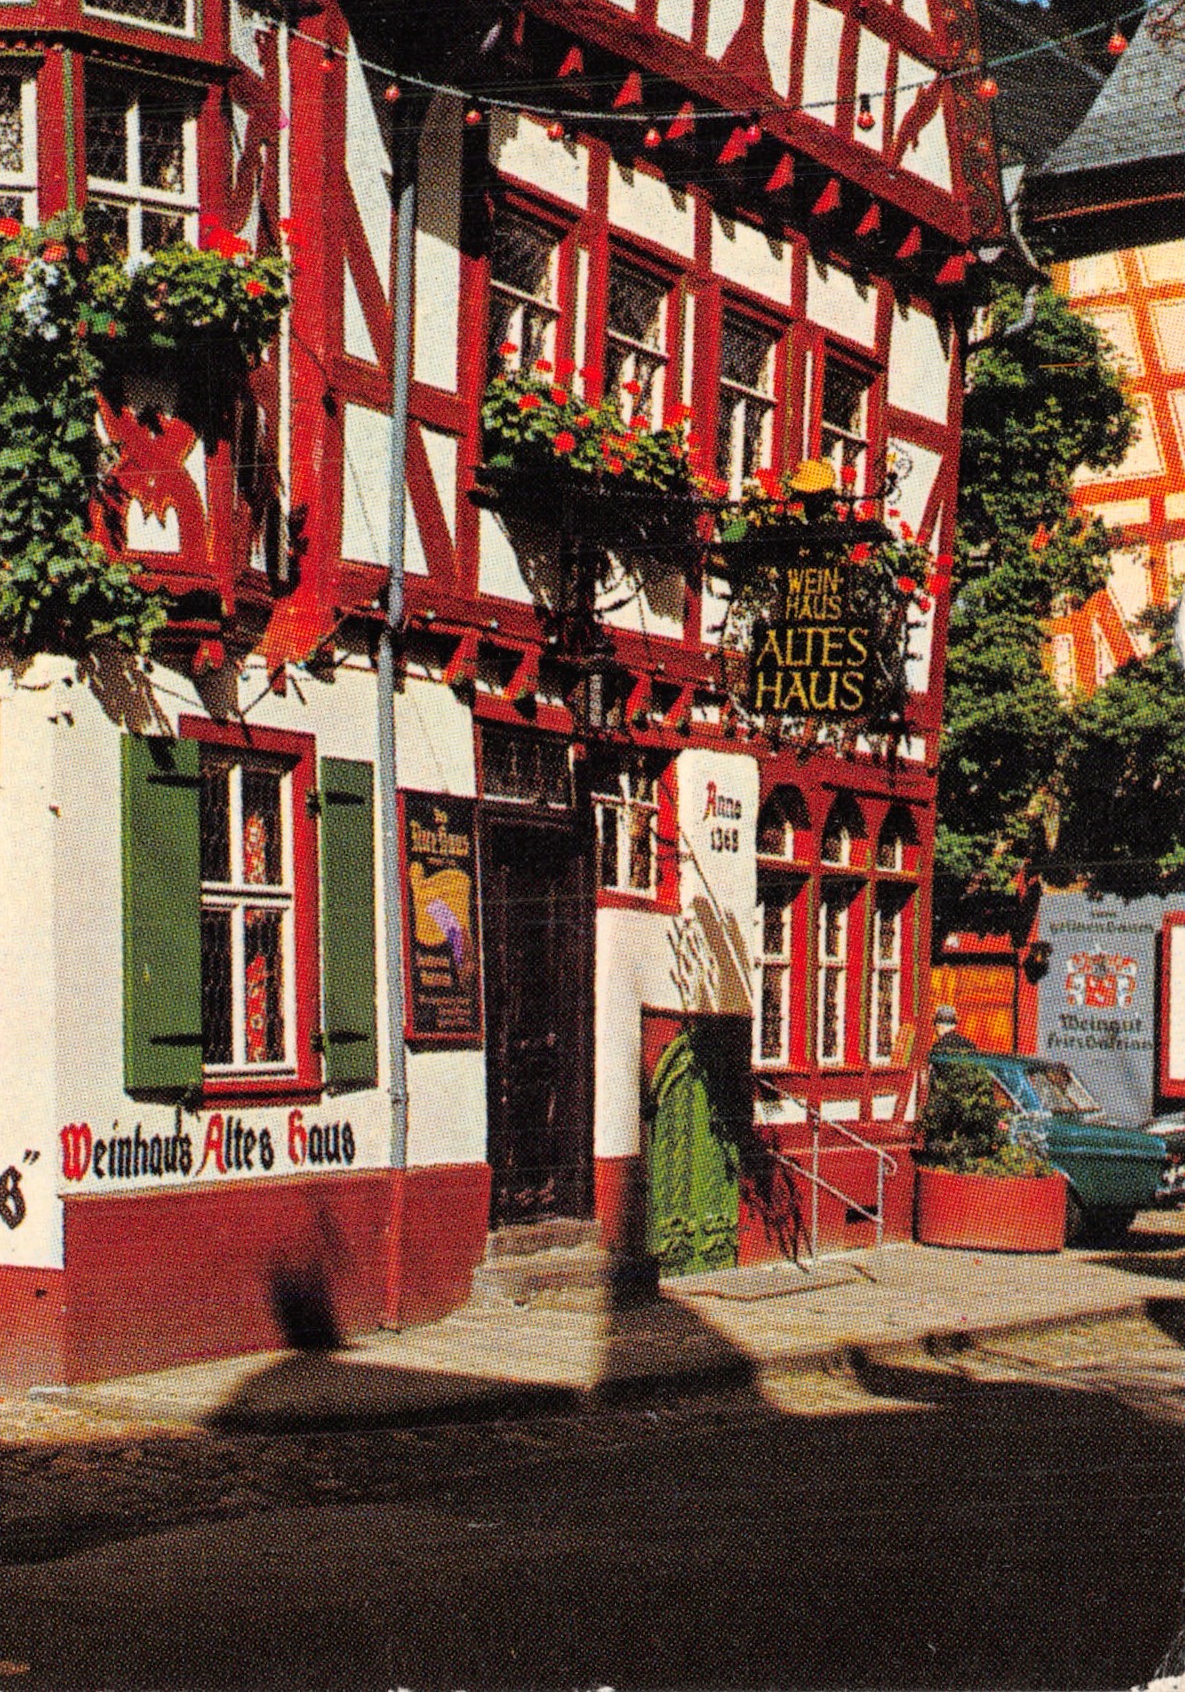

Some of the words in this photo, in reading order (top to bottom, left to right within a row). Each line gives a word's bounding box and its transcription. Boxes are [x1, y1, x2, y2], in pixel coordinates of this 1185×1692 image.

[786, 595, 842, 621] HAUS
[756, 627, 868, 667] ALTES
[755, 670, 865, 710] HAUS
[702, 780, 742, 822] Anno
[60, 1119, 194, 1182] Weinhaus
[195, 1112, 275, 1177] Altes
[287, 1108, 356, 1166] Haus
